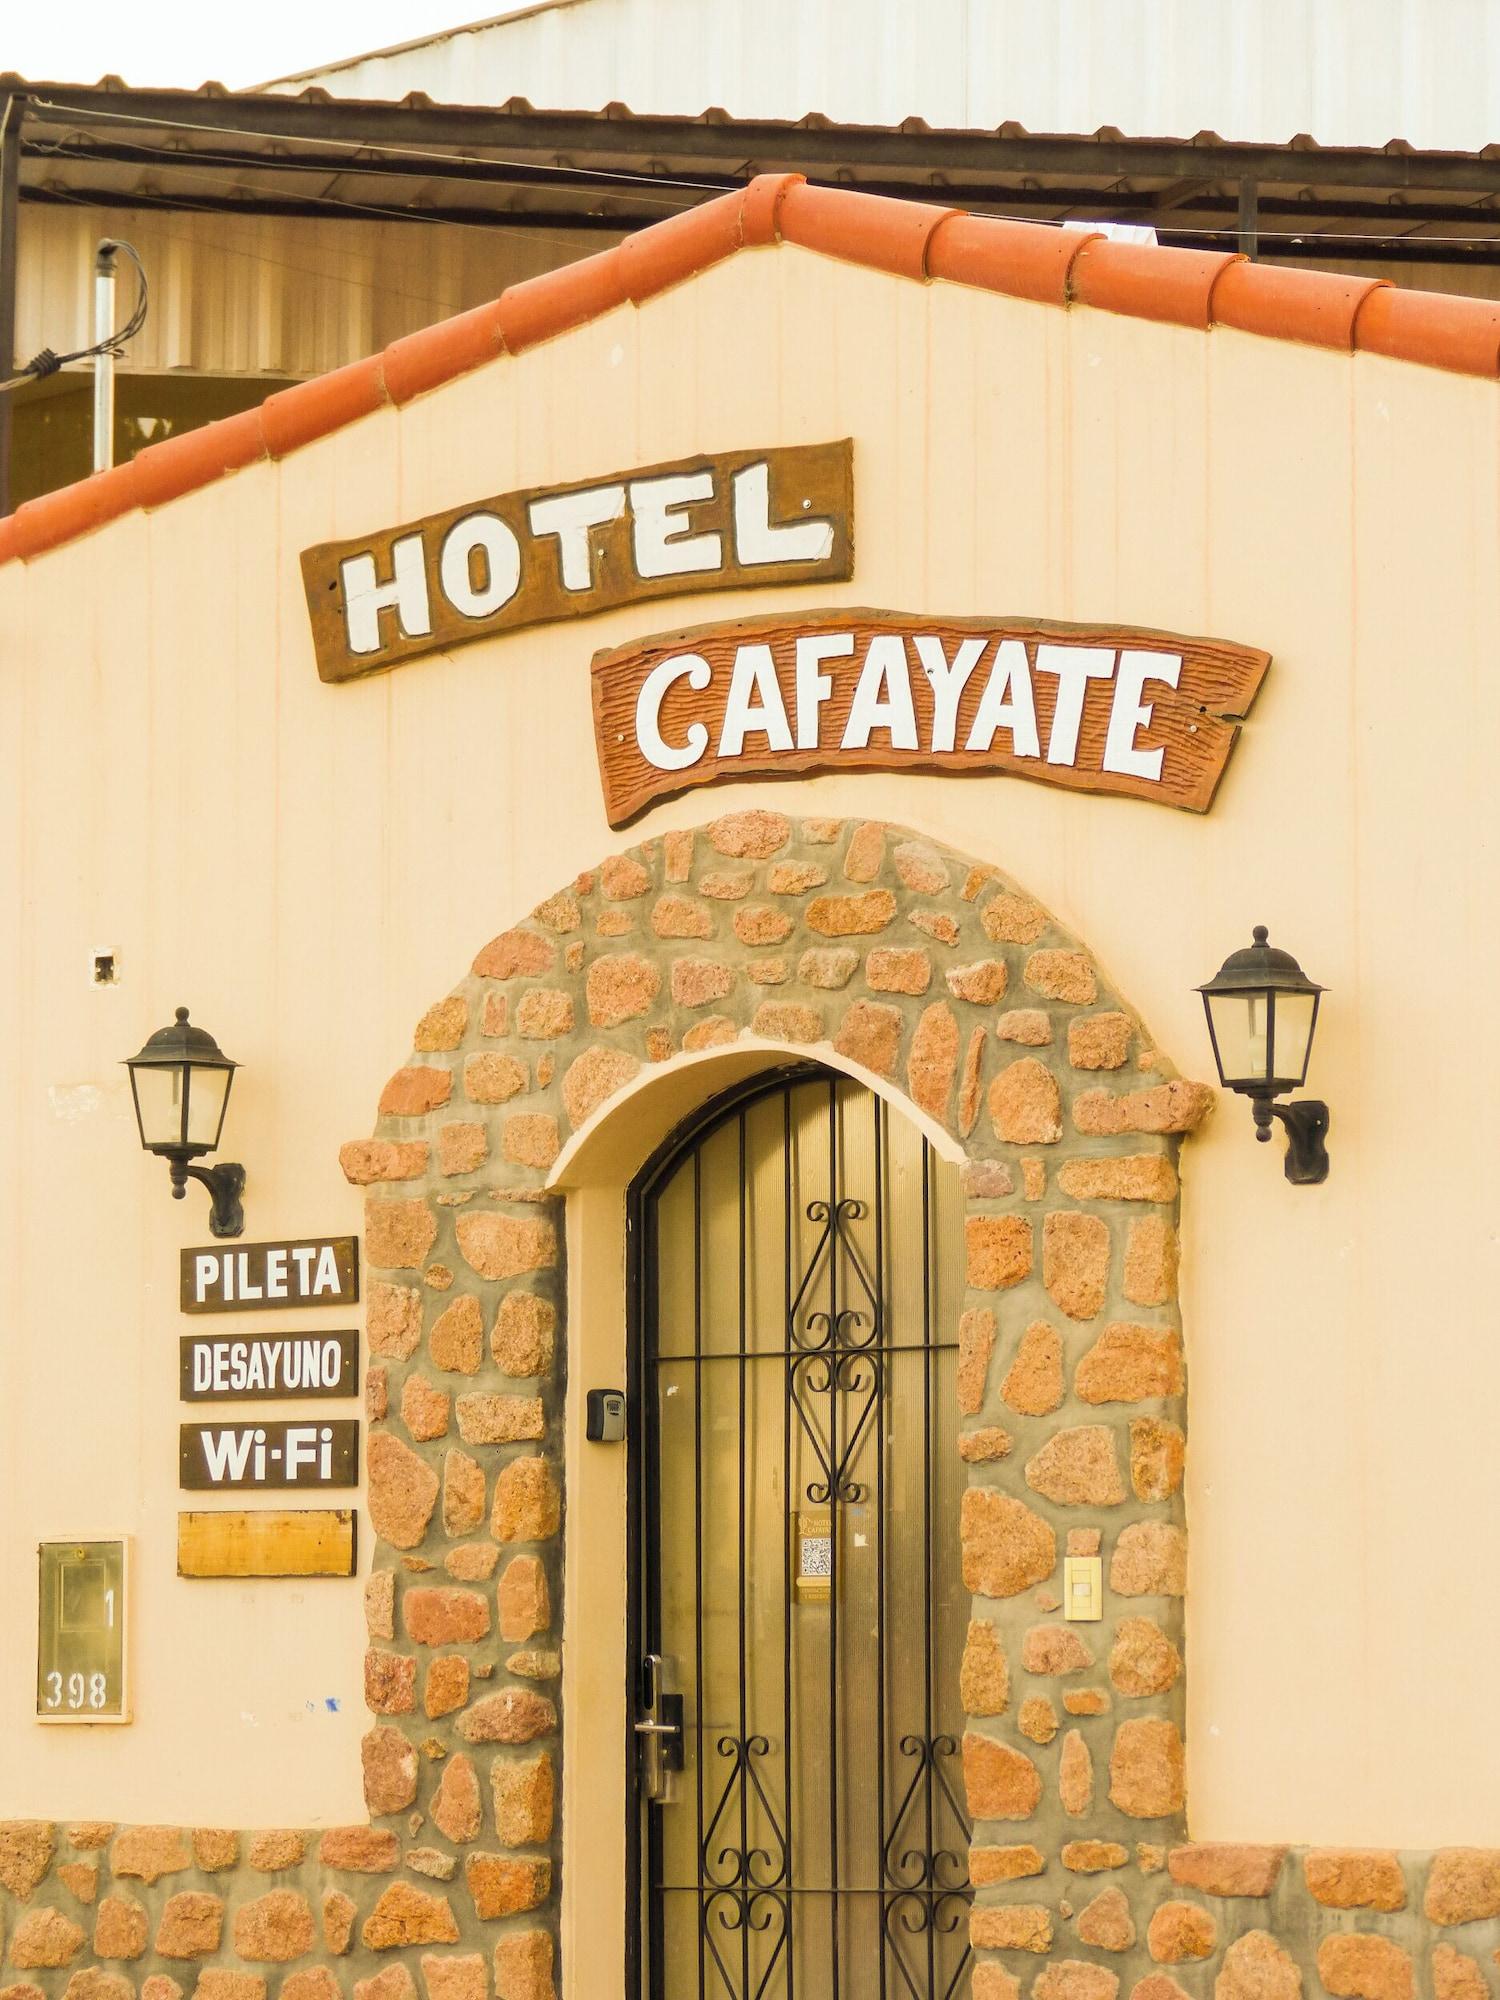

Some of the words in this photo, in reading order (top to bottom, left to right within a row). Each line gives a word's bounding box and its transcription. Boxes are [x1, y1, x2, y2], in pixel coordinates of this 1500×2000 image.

[340, 463, 834, 653] HOTEL
[634, 633, 1182, 781] CAFAYATE
[195, 1246, 342, 1302] PILETA
[193, 1340, 342, 1392] DESAYUNO
[200, 1427, 333, 1481] Wi-Fi
[105, 1589, 114, 1628] 1
[46, 1671, 106, 1709] 398
